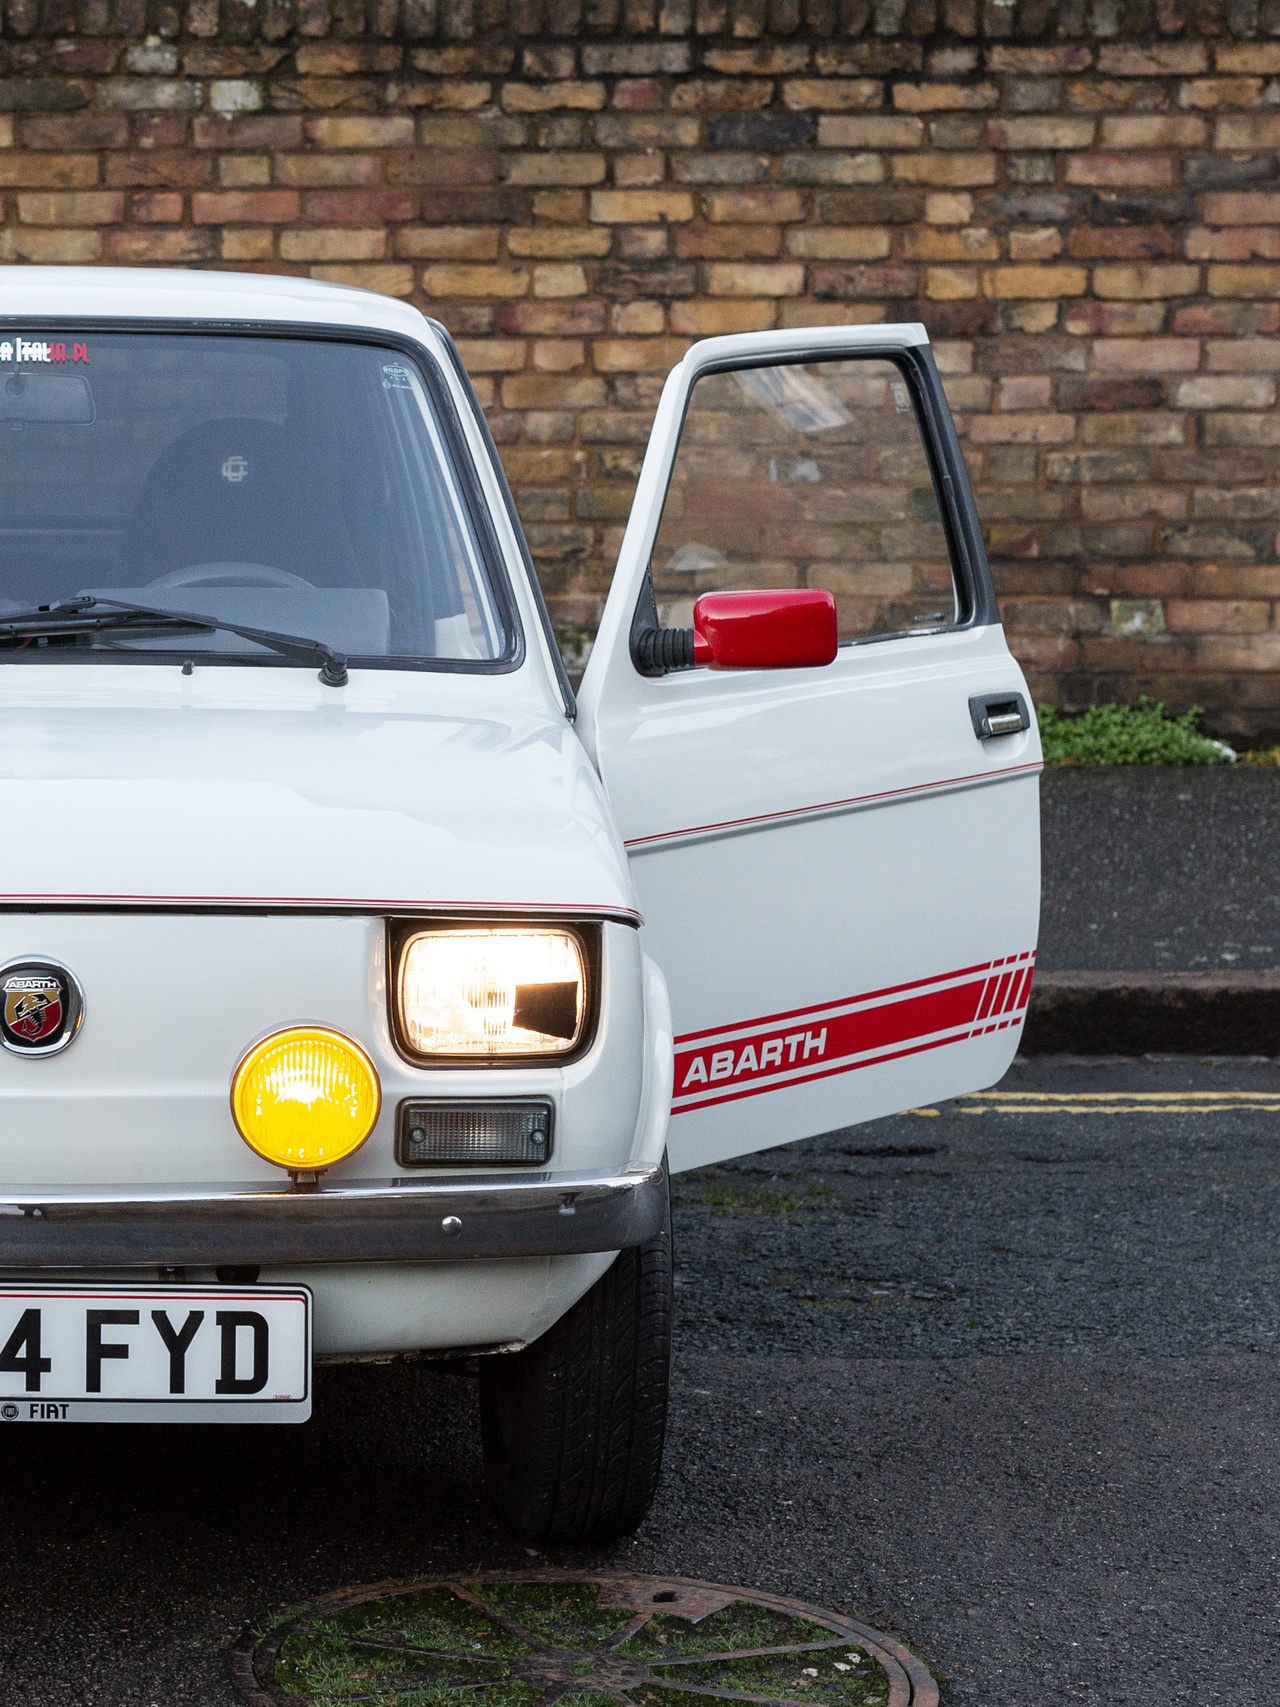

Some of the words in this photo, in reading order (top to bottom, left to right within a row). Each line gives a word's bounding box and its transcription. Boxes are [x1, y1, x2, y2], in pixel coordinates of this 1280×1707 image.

[9, 980, 57, 989] ABARTH
[681, 1027, 828, 1088] ABARTH
[86, 1309, 270, 1395] FYD
[29, 1403, 70, 1419] FIAT
